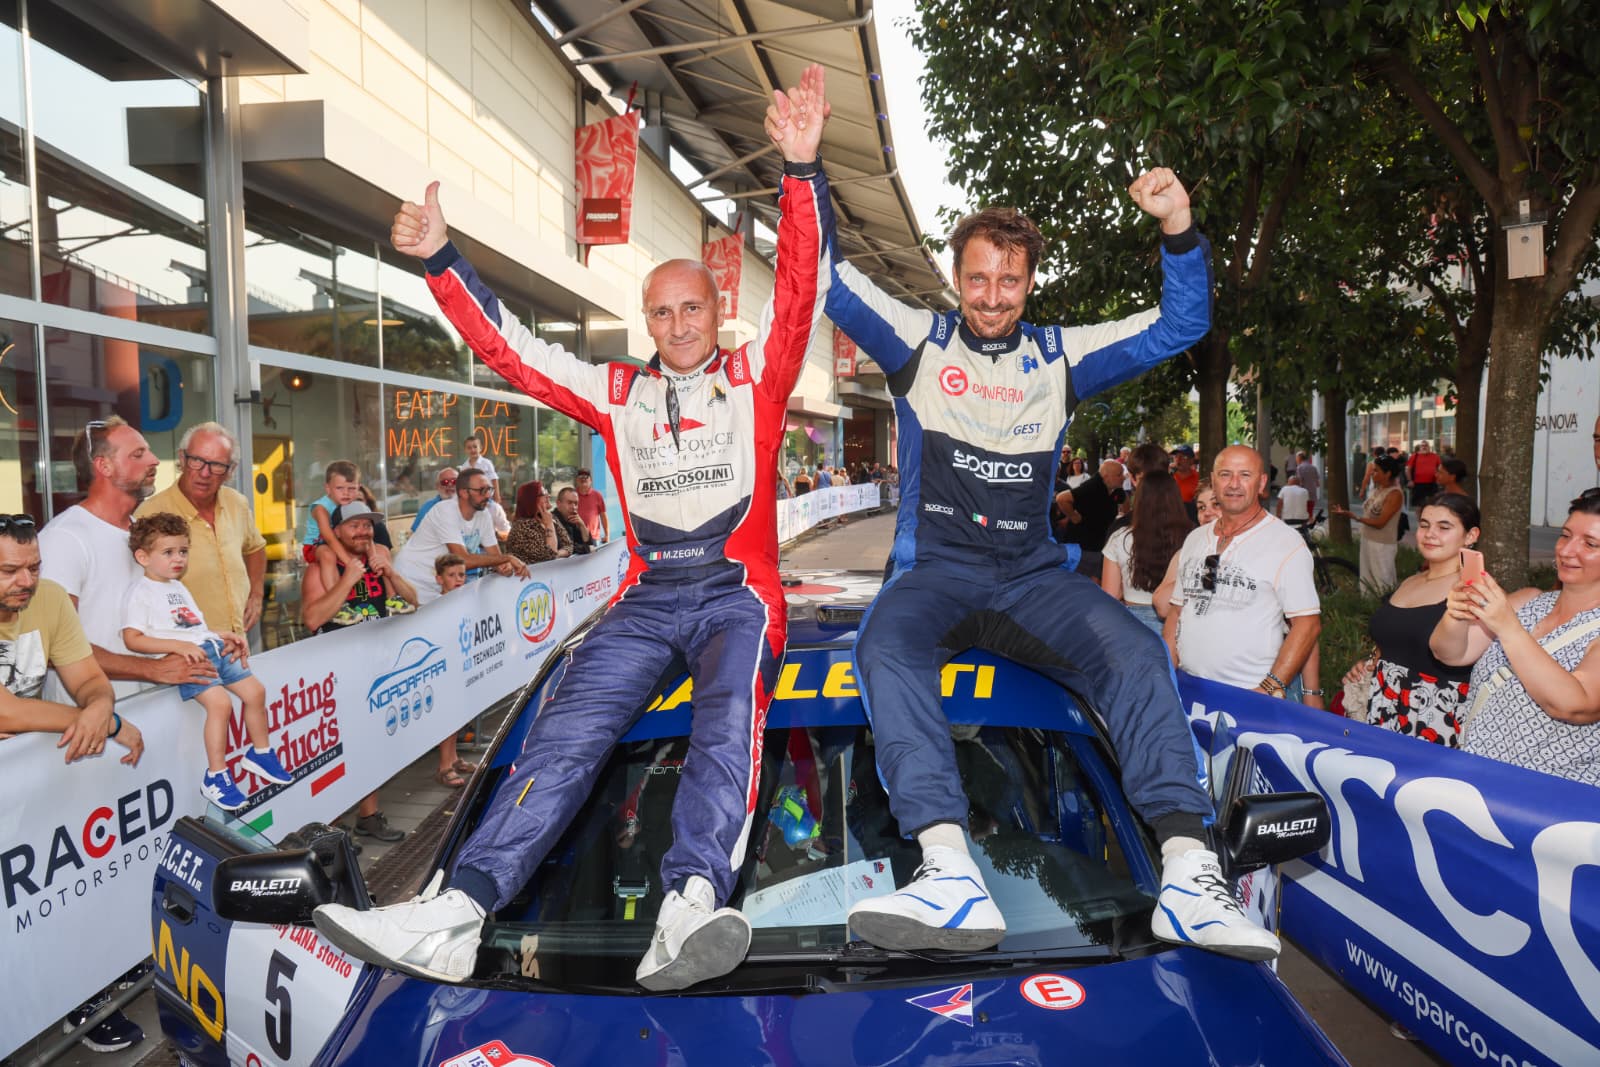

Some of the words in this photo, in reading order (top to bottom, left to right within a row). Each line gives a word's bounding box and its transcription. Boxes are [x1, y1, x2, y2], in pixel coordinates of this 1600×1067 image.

[395, 390, 432, 419] EAT
[388, 427, 453, 457] MAKE
[1013, 422, 1041, 436] GEST
[952, 449, 1034, 482] sparco
[925, 502, 954, 515] sparco
[996, 519, 1028, 531] PINZANO
[662, 547, 705, 560] M.ZEGNA
[521, 592, 552, 629] CAM
[474, 613, 503, 647] ARCA
[224, 671, 336, 755] Mrking
[225, 716, 340, 796] Prducts
[1257, 818, 1317, 836] BALLETTI
[0, 779, 174, 909] RACED
[230, 877, 301, 892] BALLETTI
[289, 923, 319, 955] LANA
[316, 944, 352, 979] storico
[264, 948, 298, 1062] 5
[1034, 980, 1073, 1002] E
